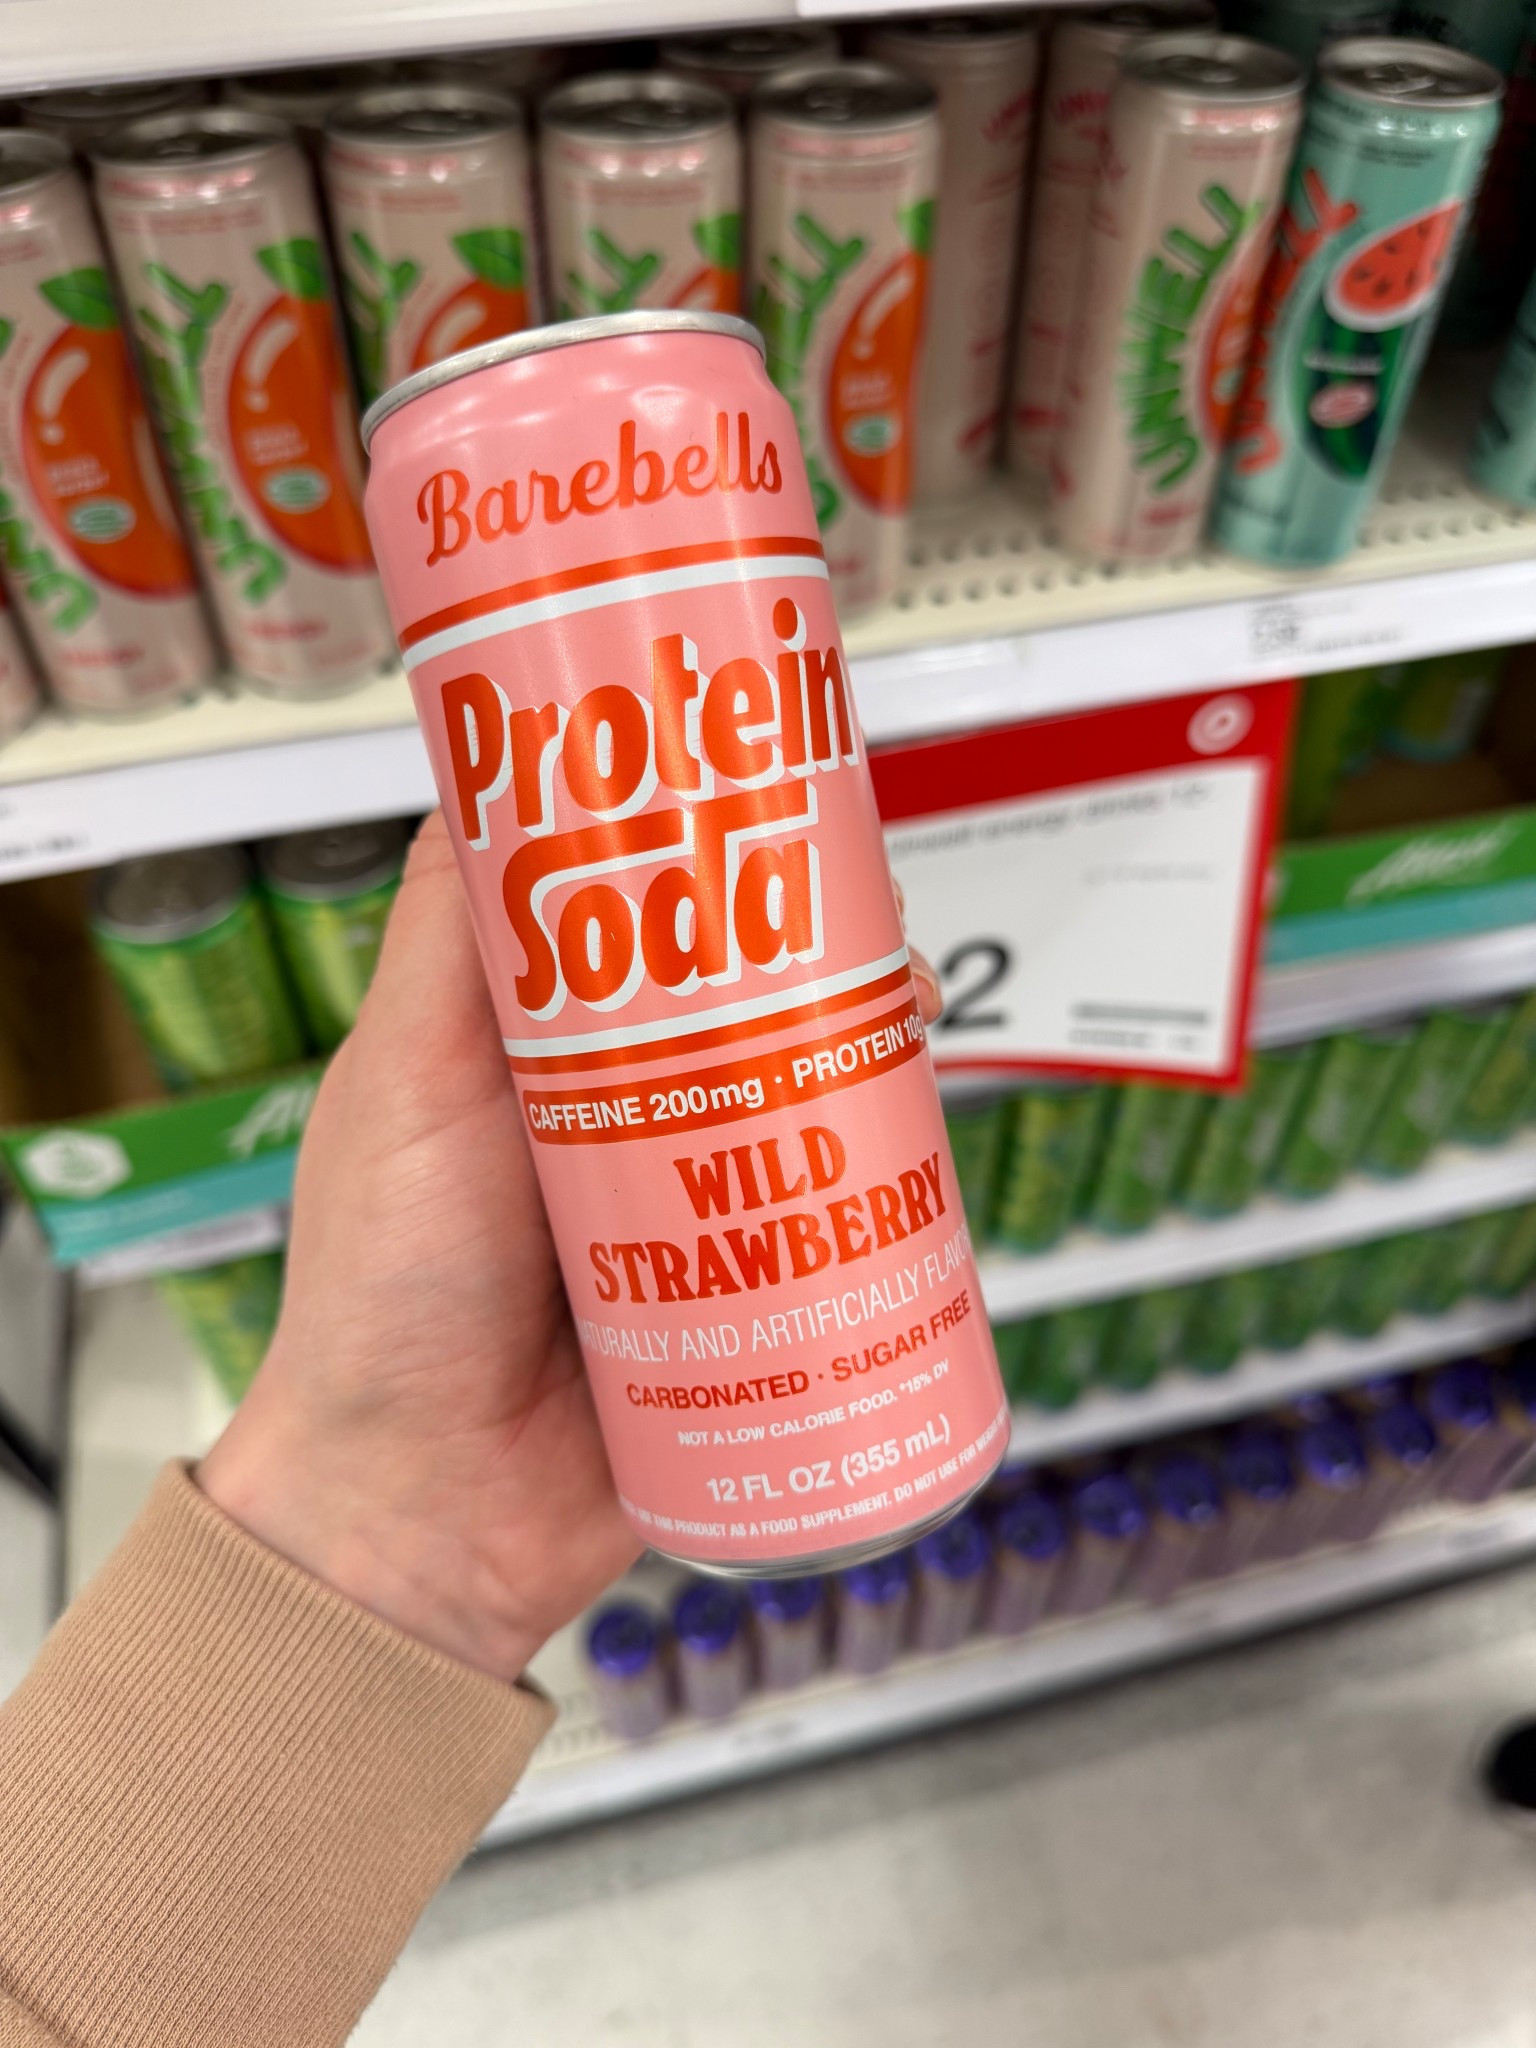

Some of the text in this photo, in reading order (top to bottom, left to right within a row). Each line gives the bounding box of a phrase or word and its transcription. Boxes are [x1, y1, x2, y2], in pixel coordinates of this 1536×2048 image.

[417, 411, 782, 567] Barebells
[441, 598, 857, 848] Protein
[502, 779, 815, 1017] Soda
[528, 1013, 924, 1131] CAFFEINE 200mg PROTEIN 10g
[589, 1151, 946, 1304] STRAWBERRY
[673, 1126, 847, 1220] WILD
[627, 1288, 971, 1409] CARBONATED SUGAR FREE
[681, 1324, 741, 1361] AND
[751, 1263, 919, 1353] ARTIFICIALLY
[677, 1430, 709, 1446] NOT
[713, 1431, 725, 1444] A
[727, 1426, 765, 1444] LOW
[769, 1406, 846, 1437] CALORIE
[848, 1389, 898, 1418] FOOD.
[933, 1358, 950, 1380] DV
[706, 1412, 951, 1502] 12 FL OZ (355 mL)
[674, 1518, 726, 1537] PRODUCT
[730, 1523, 746, 1537] AS
[750, 1522, 759, 1535] A
[761, 1517, 797, 1535] FOOD
[802, 1492, 891, 1529] SUPPLEMENT.
[893, 1484, 912, 1502] DO
[914, 1469, 937, 1492] NOT
[938, 1457, 958, 1480] USE
[958, 1443, 977, 1467] FOR
